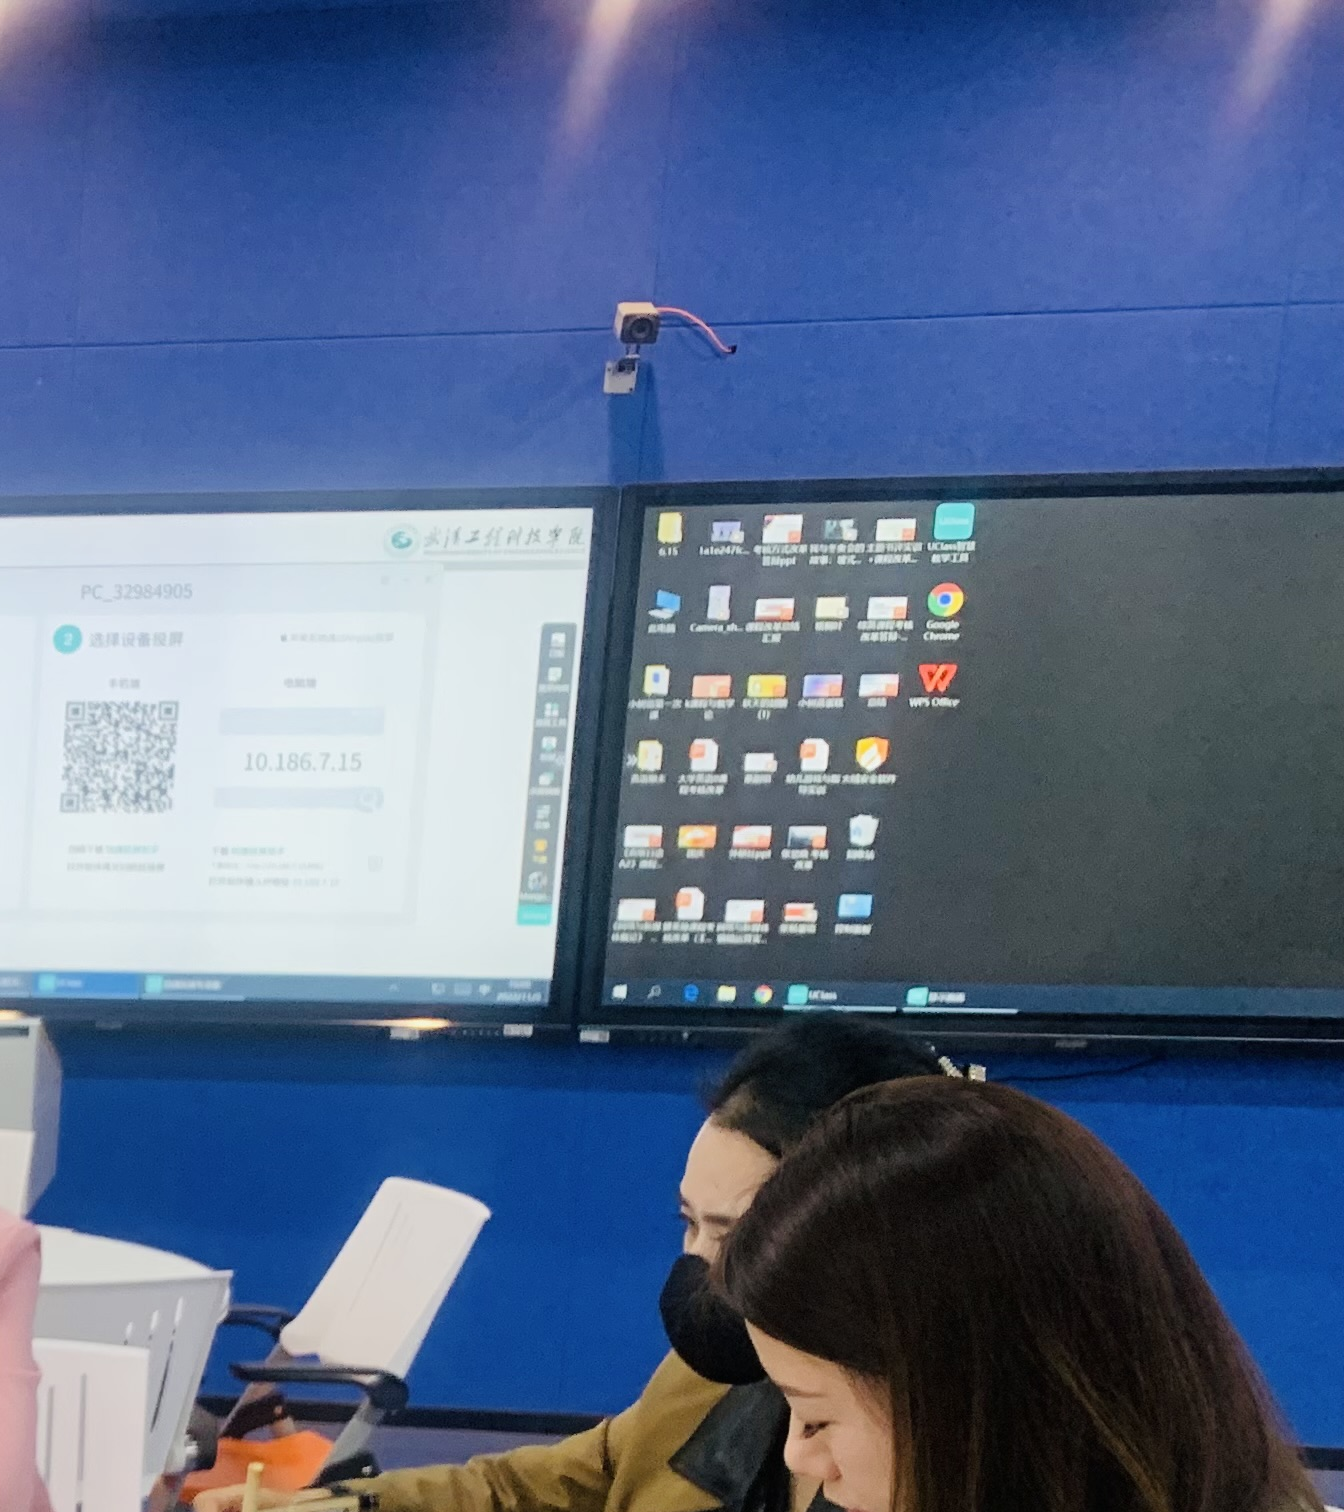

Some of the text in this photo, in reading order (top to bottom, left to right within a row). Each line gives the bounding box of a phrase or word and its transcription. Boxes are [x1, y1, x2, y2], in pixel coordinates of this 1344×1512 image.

[80, 583, 194, 603] PC_32984905
[925, 619, 960, 632] Google
[922, 630, 960, 642] Chrome
[909, 697, 960, 709] WPS Office
[243, 751, 364, 773] 10.186.7.15
